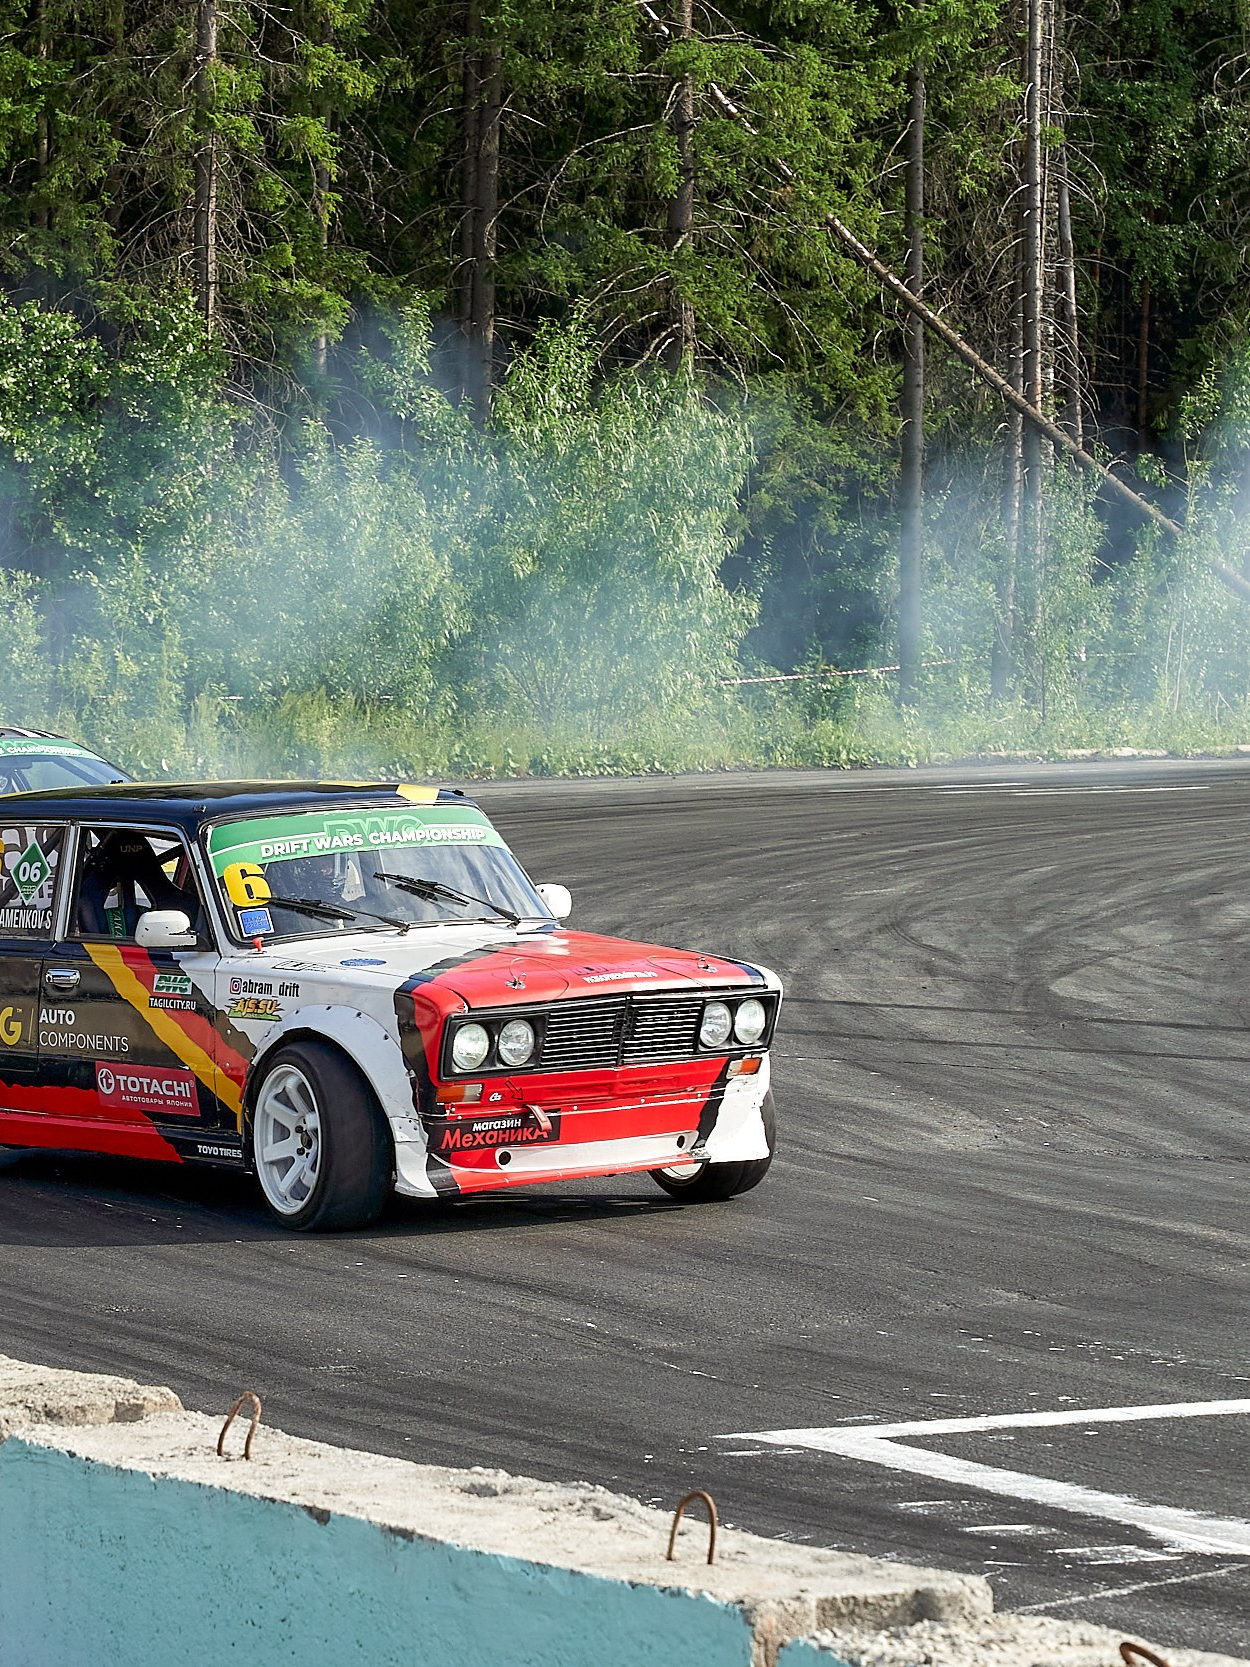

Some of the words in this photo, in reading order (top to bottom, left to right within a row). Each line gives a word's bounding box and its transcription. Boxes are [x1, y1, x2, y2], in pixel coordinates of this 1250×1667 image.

[261, 840, 309, 859] DRIFT
[313, 834, 363, 850] WARS
[368, 828, 485, 845] CHAMPIONSHIP
[19, 861, 42, 882] 06
[223, 862, 271, 907] 6
[45, 910, 52, 929] S
[150, 998, 196, 1010] TAGILCITY.RU
[39, 1008, 75, 1026] AUTO
[39, 1031, 129, 1052] COMPONENTS
[116, 1075, 191, 1098] TOTACHI
[472, 1118, 522, 1132] магазин
[197, 1145, 218, 1155] TOYO
[218, 1147, 243, 1158] TIRES
